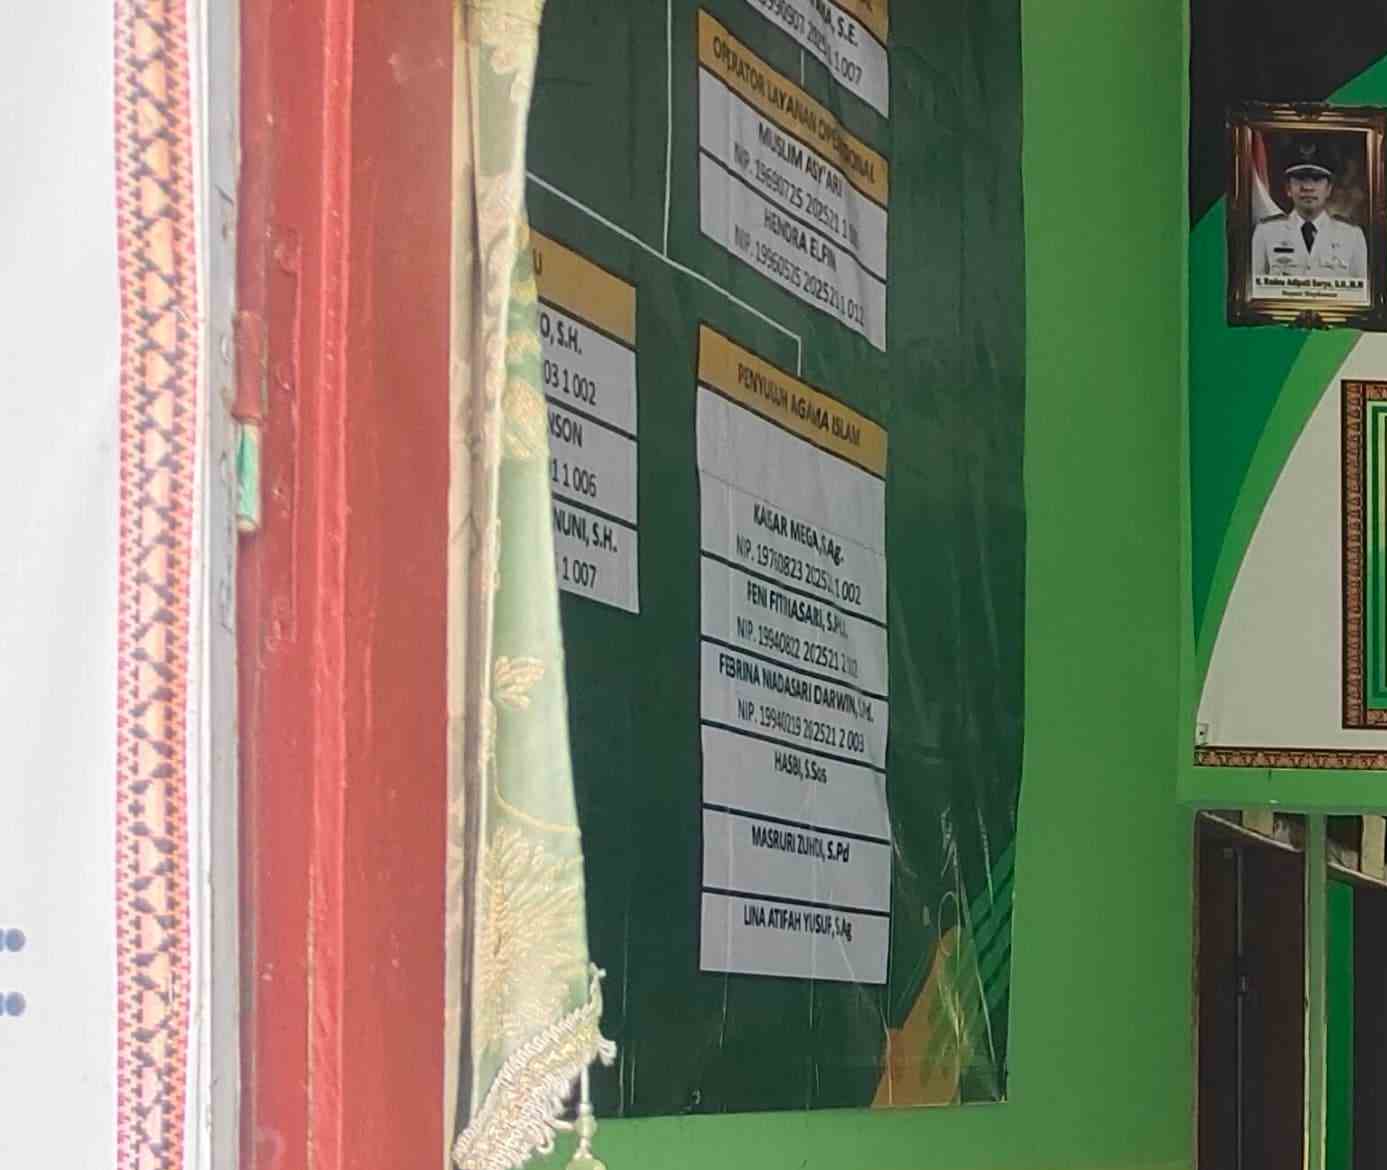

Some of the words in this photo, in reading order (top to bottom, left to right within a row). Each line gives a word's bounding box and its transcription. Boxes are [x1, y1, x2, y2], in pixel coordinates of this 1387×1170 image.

[557, 321, 582, 355] S.H.
[573, 373, 597, 407] 002
[553, 508, 590, 548] NUNI,
[592, 526, 618, 553] S.H.
[573, 559, 597, 590] 007
[752, 824, 796, 855] MASRURI
[828, 840, 850, 863] S.Pd
